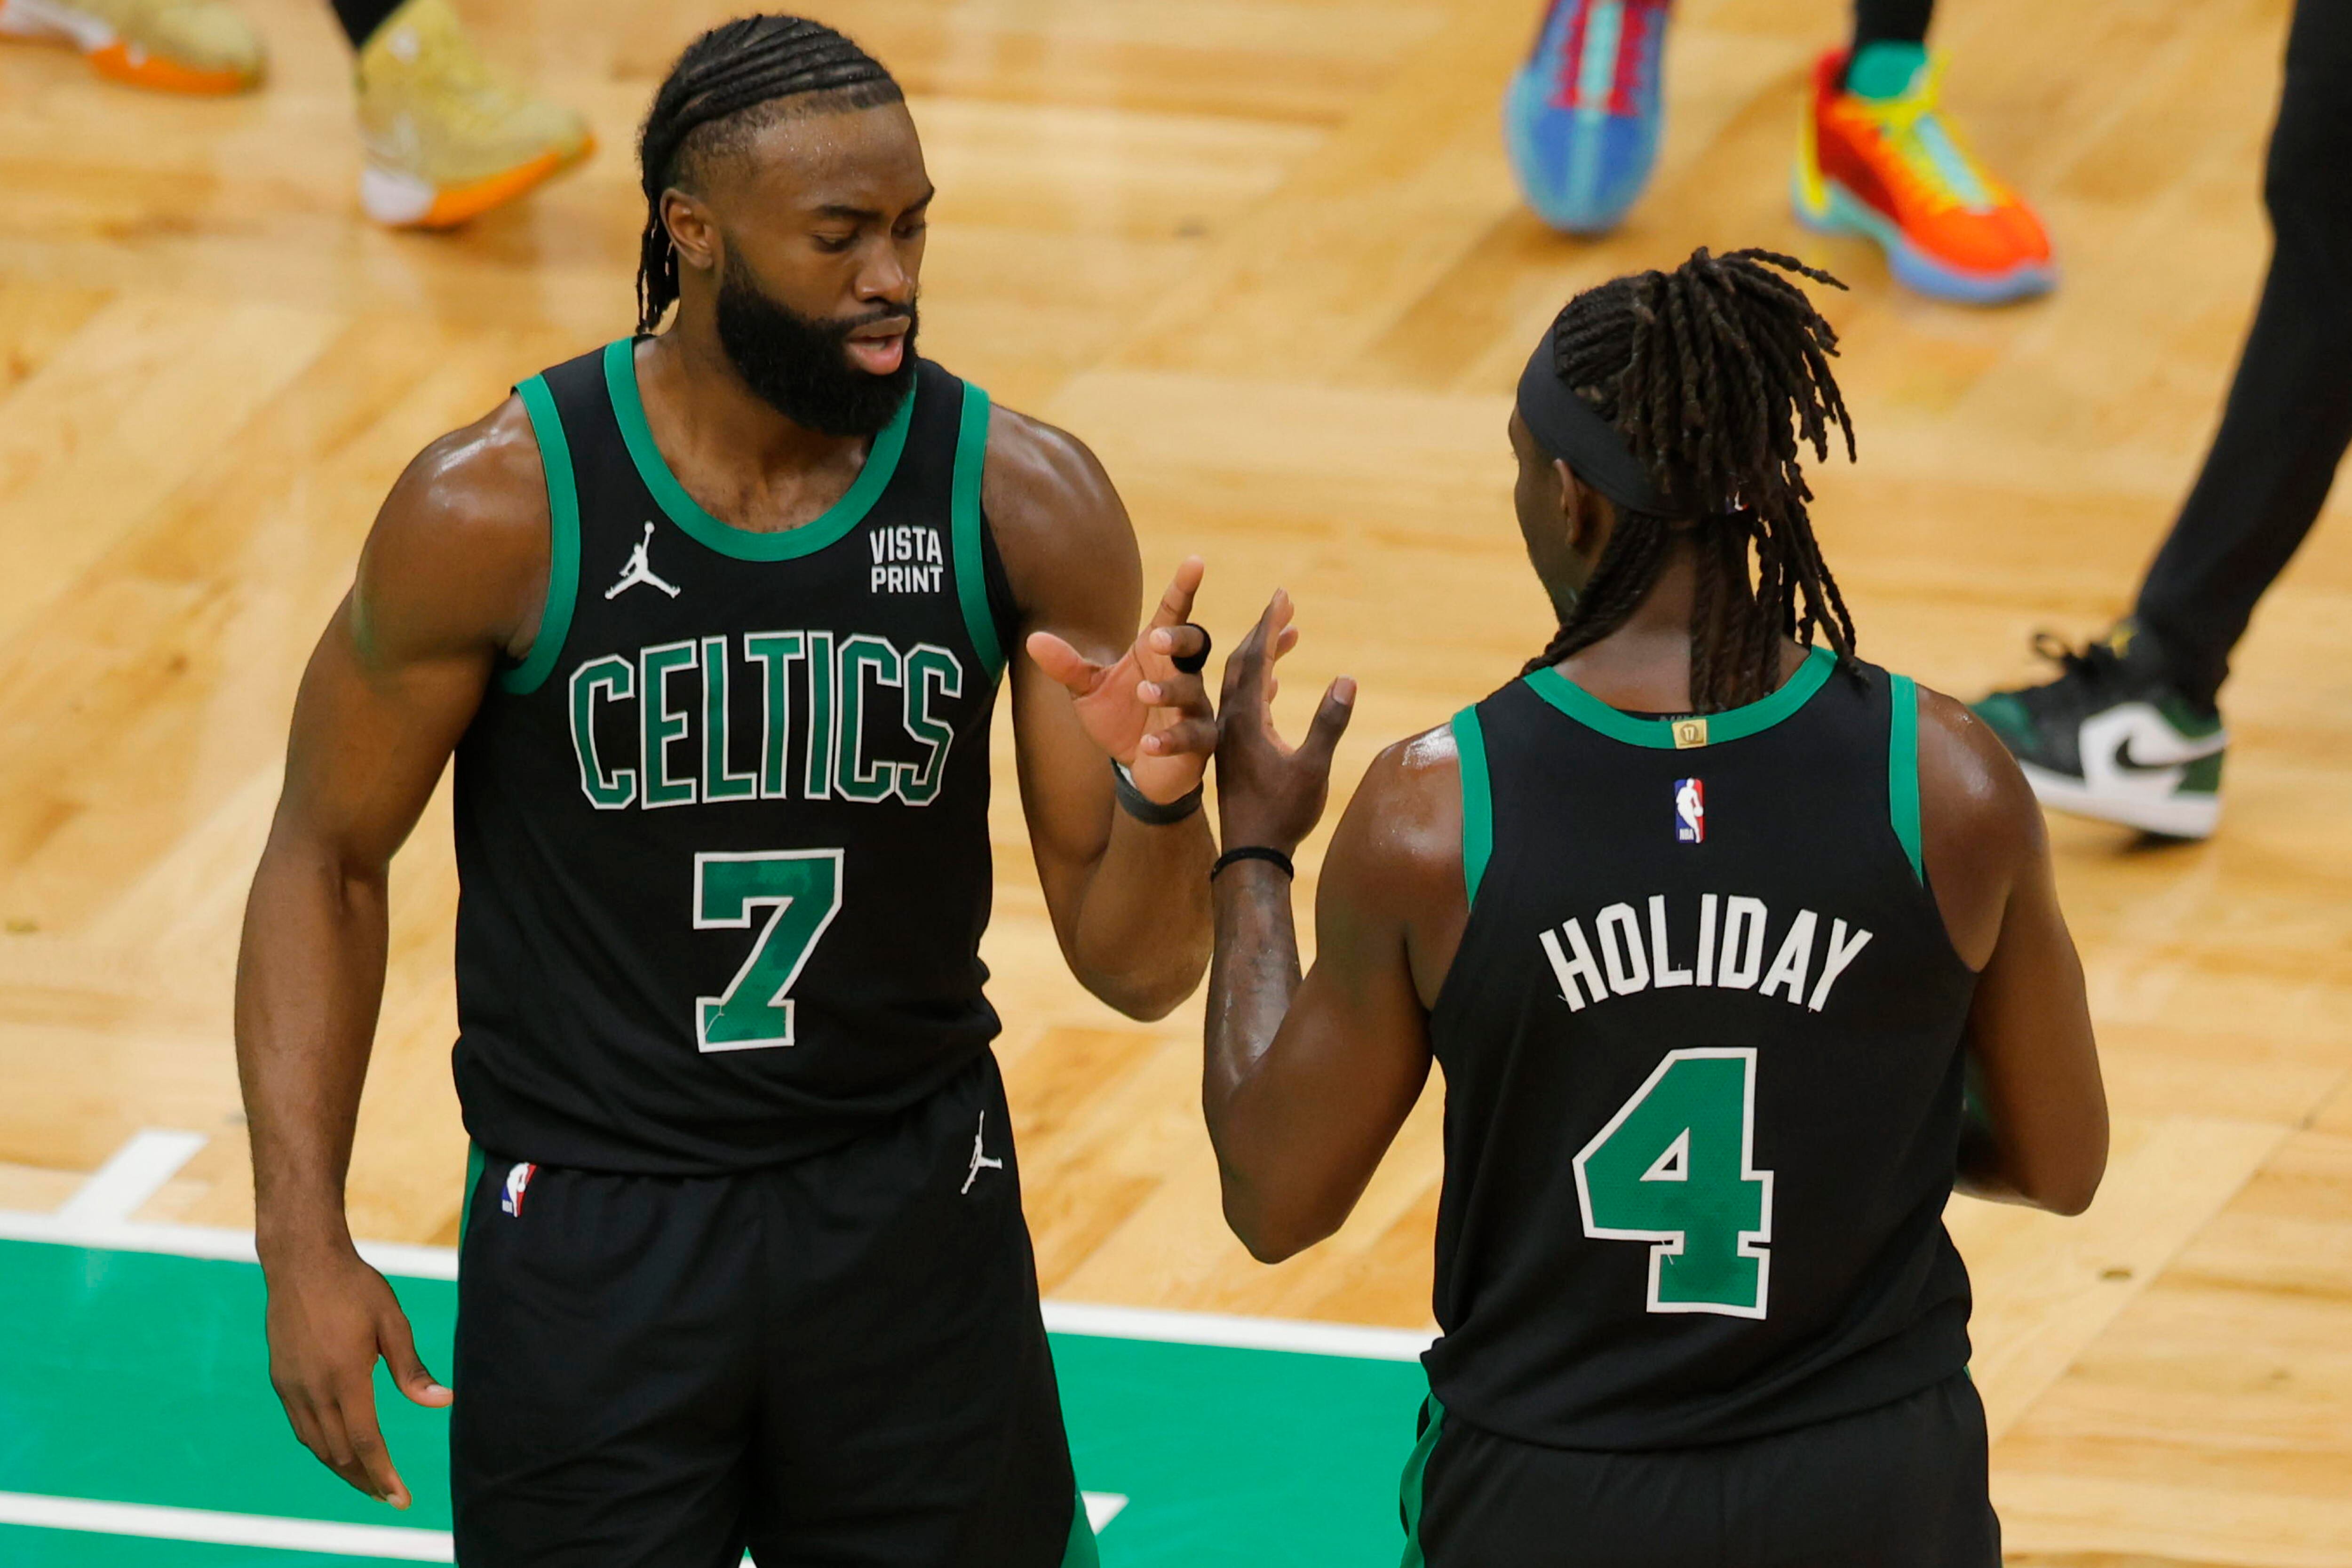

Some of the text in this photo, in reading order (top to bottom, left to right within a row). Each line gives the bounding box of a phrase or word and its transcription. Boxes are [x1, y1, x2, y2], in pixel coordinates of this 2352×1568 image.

[869, 525, 944, 565] VISTA
[871, 565, 944, 593] PRINT
[569, 630, 962, 810] CELTICS
[693, 848, 845, 1054] 7
[1539, 894, 1873, 1012] HOLIDAY
[1572, 1047, 1774, 1320] 4
